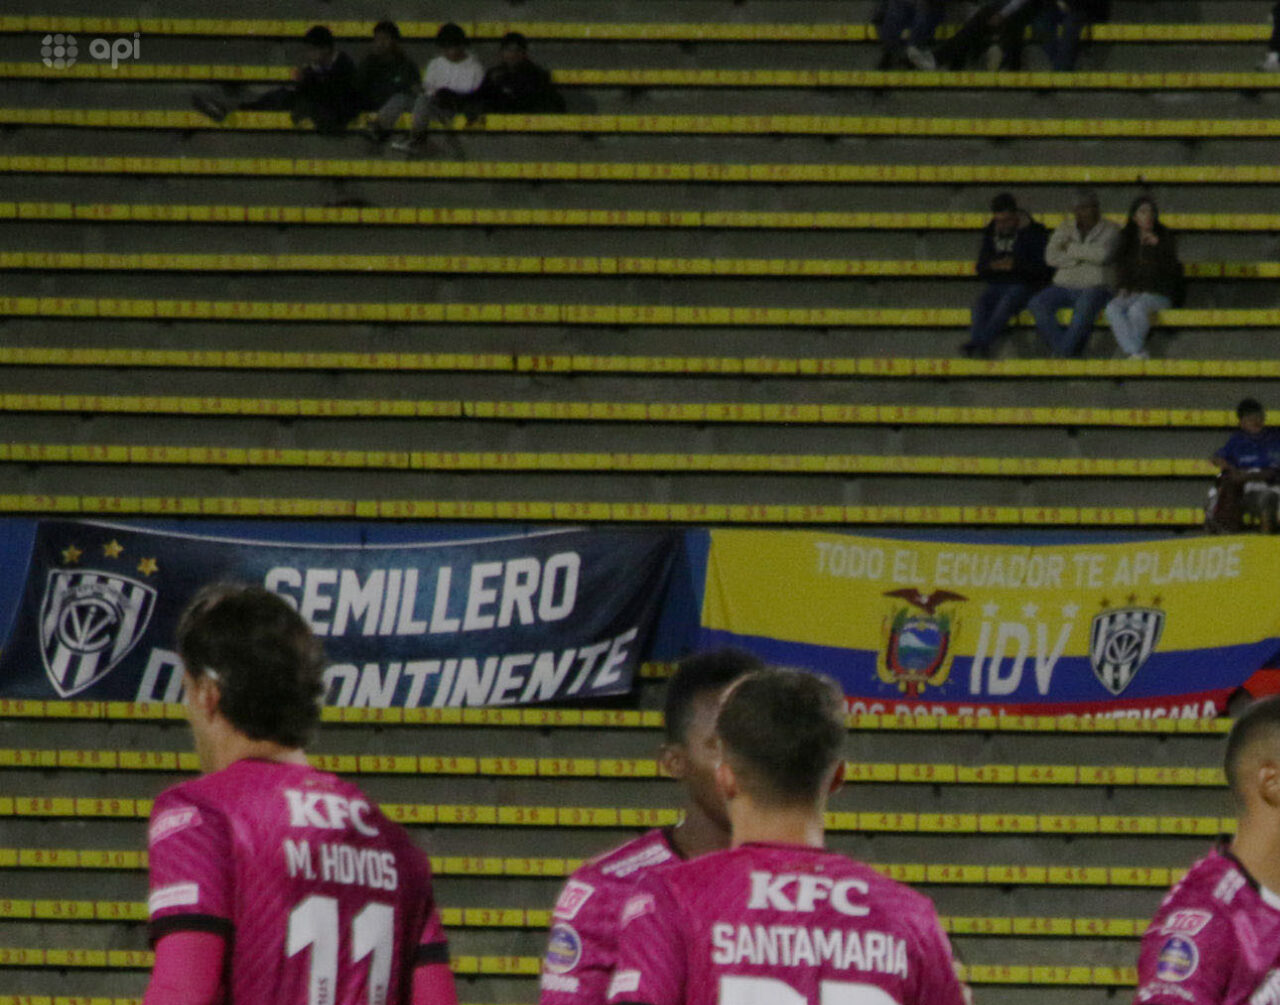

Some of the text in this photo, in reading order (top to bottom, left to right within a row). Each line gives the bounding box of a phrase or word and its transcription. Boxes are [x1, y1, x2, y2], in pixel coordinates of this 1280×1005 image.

[815, 543, 1245, 588] TODO EL ECUADOR TE APLAUDE
[264, 551, 581, 638] SEMILLERO
[322, 627, 638, 708] ONTINENTE
[969, 618, 1073, 695] IDV
[285, 789, 379, 837] KFC
[284, 839, 397, 891] M. HOYOS
[747, 871, 871, 917] KFC
[712, 922, 908, 980] SANTAMARIA
